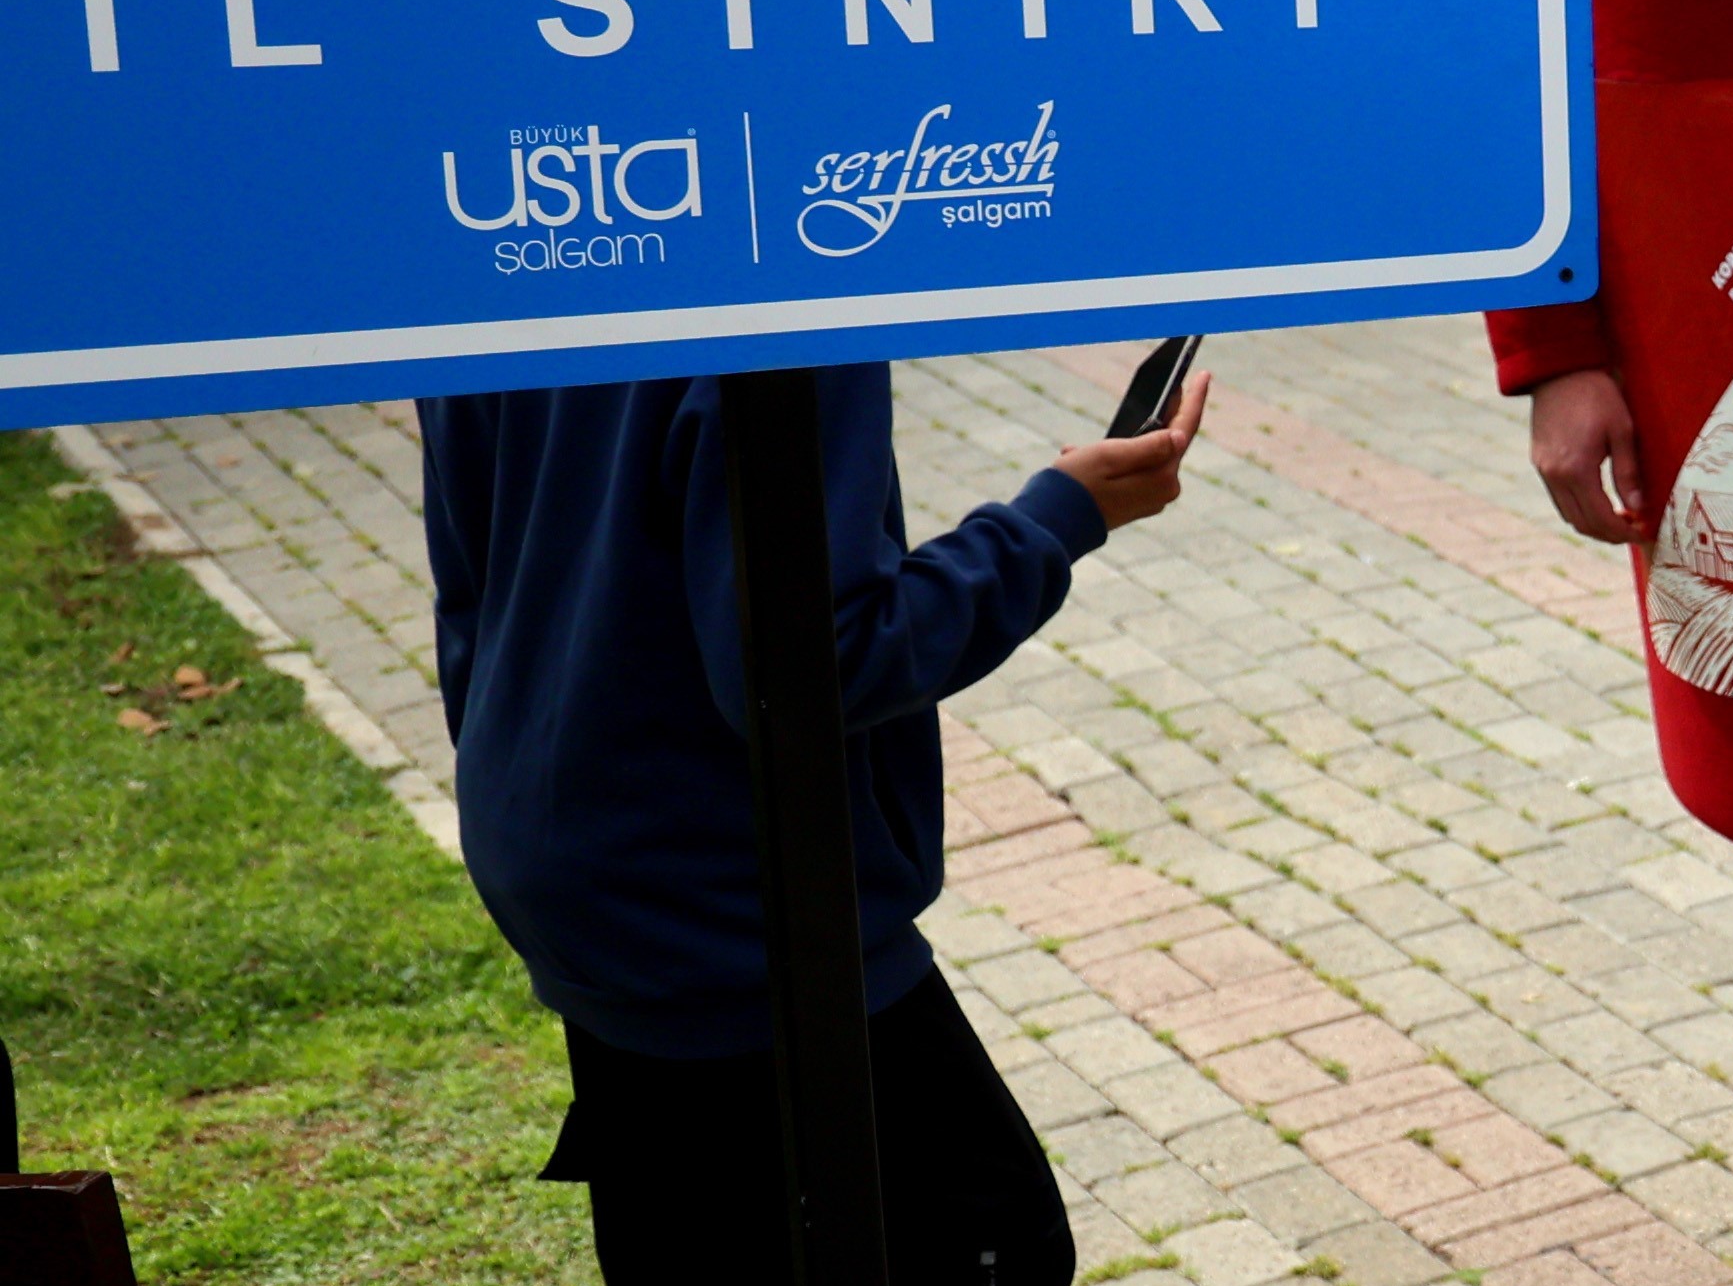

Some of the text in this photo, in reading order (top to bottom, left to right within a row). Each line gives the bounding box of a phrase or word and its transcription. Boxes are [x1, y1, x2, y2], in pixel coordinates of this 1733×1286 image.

[510, 127, 584, 146] BÜYÜK
[443, 125, 703, 231] usta
[797, 100, 1061, 258] serfressh
[942, 198, 1052, 229] şalgam
